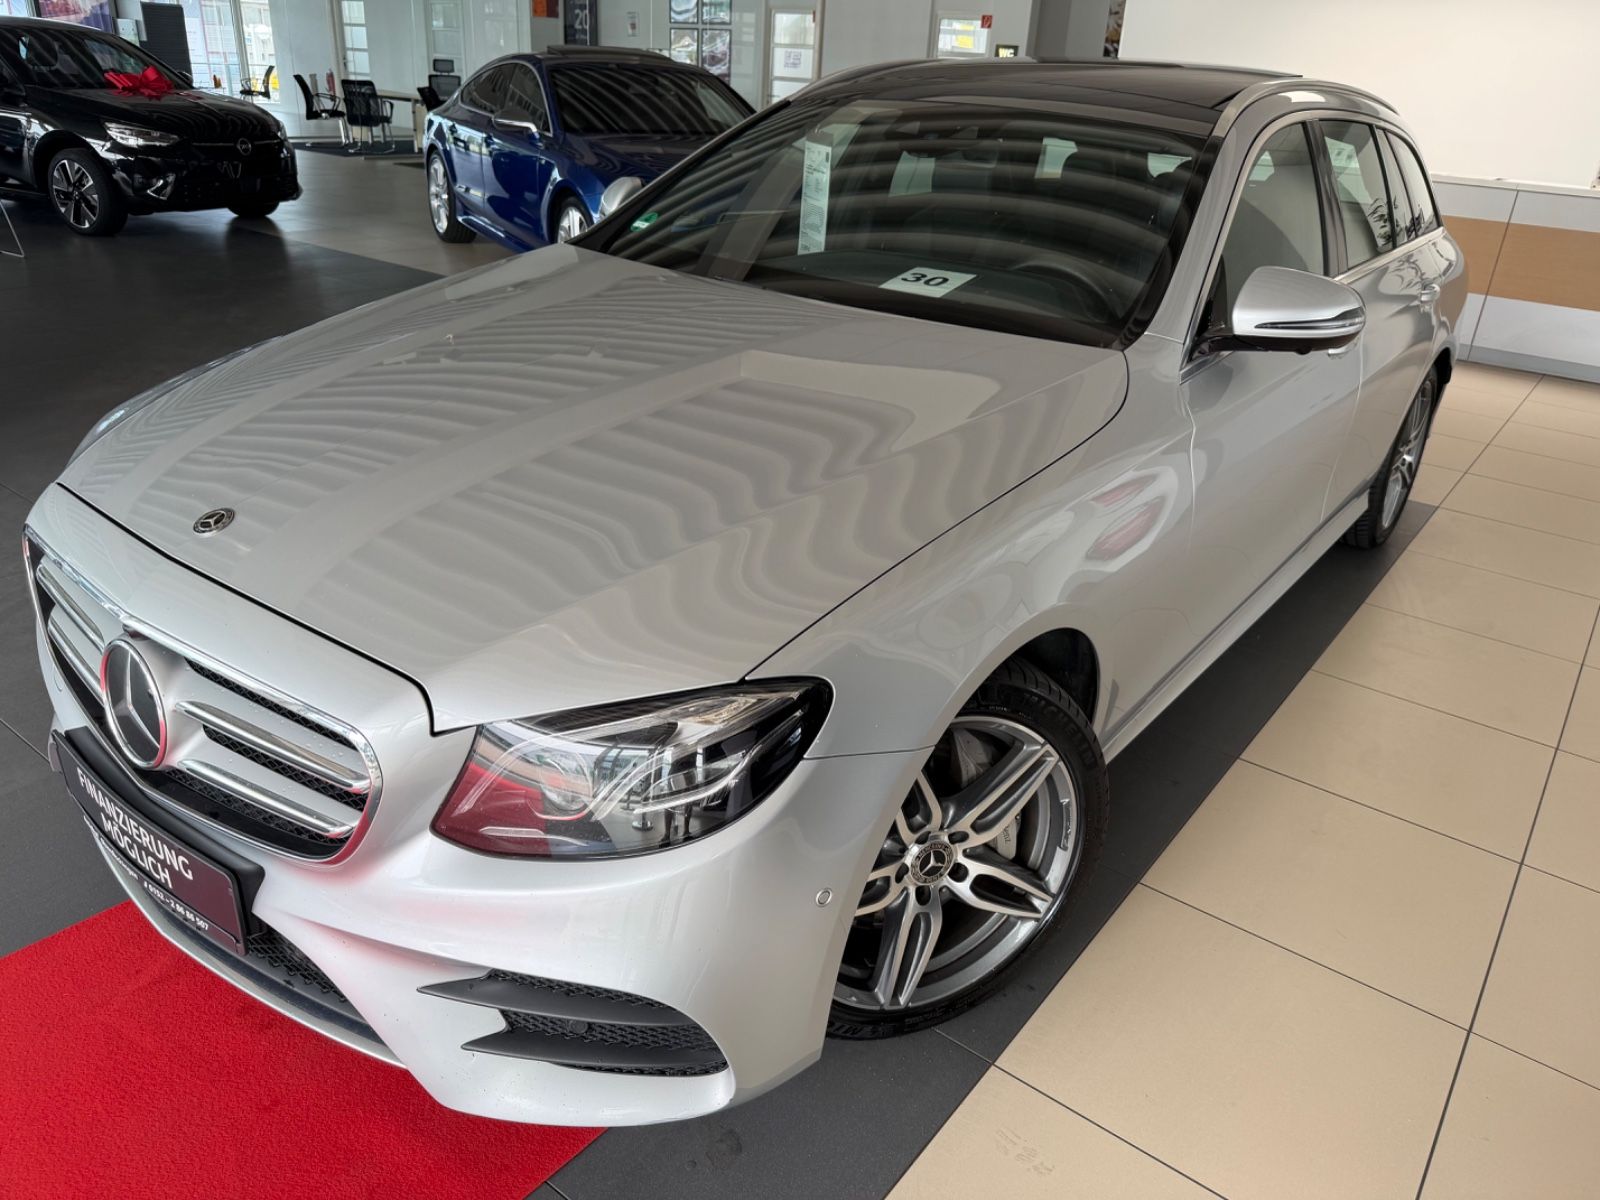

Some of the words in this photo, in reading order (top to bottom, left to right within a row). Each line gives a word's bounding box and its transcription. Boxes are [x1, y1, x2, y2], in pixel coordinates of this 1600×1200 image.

[998, 48, 1015, 58] WC
[901, 272, 950, 287] 30
[76, 766, 194, 881] FINANZIERUNG
[101, 812, 173, 889] MÖGLICH
